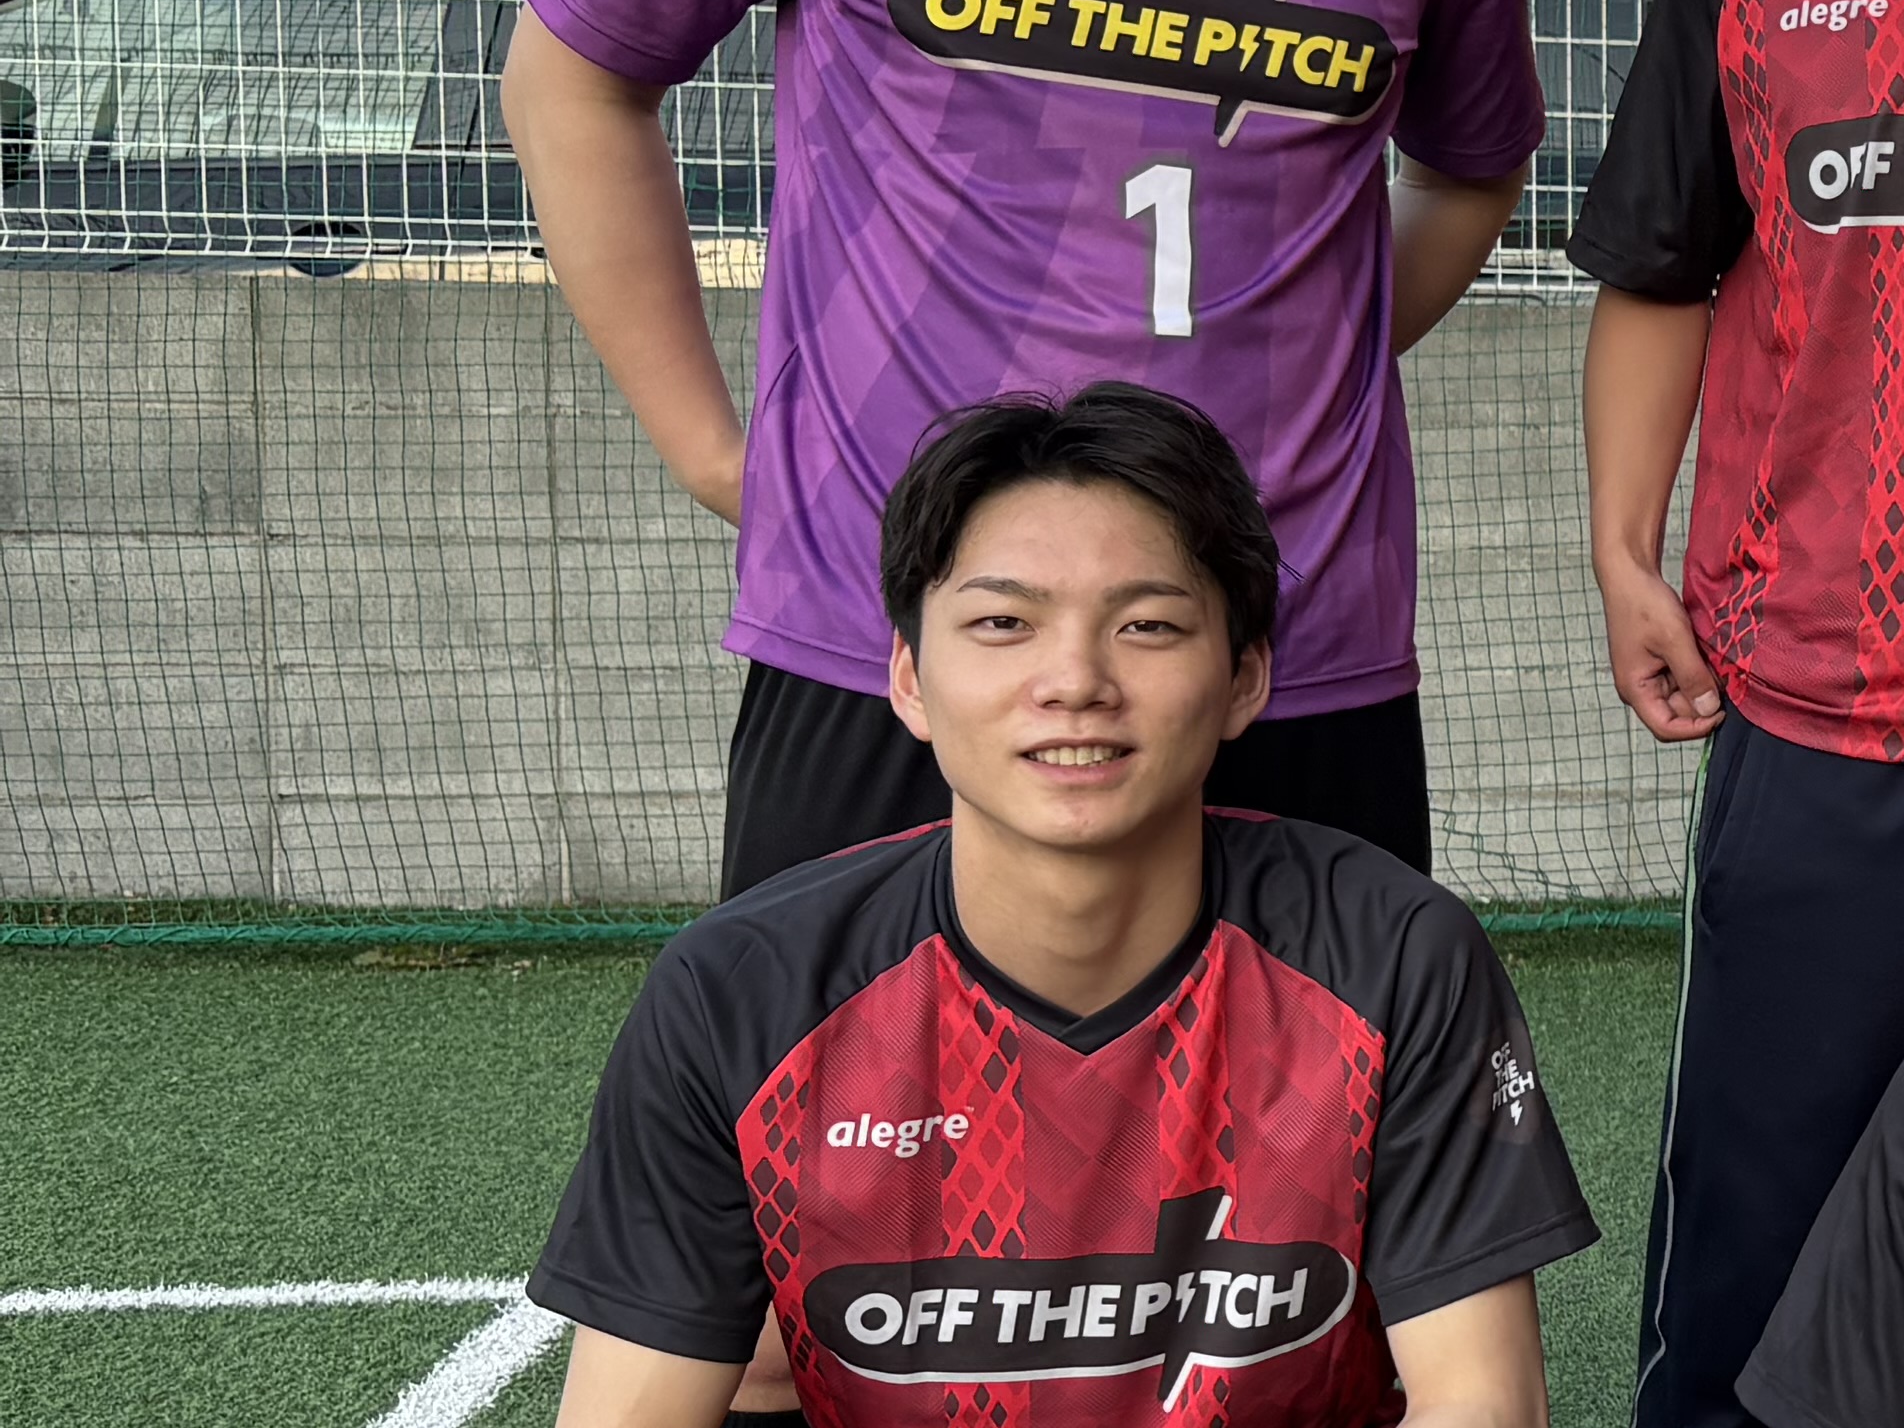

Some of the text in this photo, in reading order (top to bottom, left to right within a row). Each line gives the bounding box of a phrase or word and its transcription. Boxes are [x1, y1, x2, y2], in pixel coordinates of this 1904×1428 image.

[1193, 16, 1375, 93] PITCH
[1808, 141, 1895, 200] OFF
[1125, 164, 1193, 337] 1
[827, 1113, 969, 1158] alegre
[844, 1267, 1309, 1348] OFF THE PITCH
